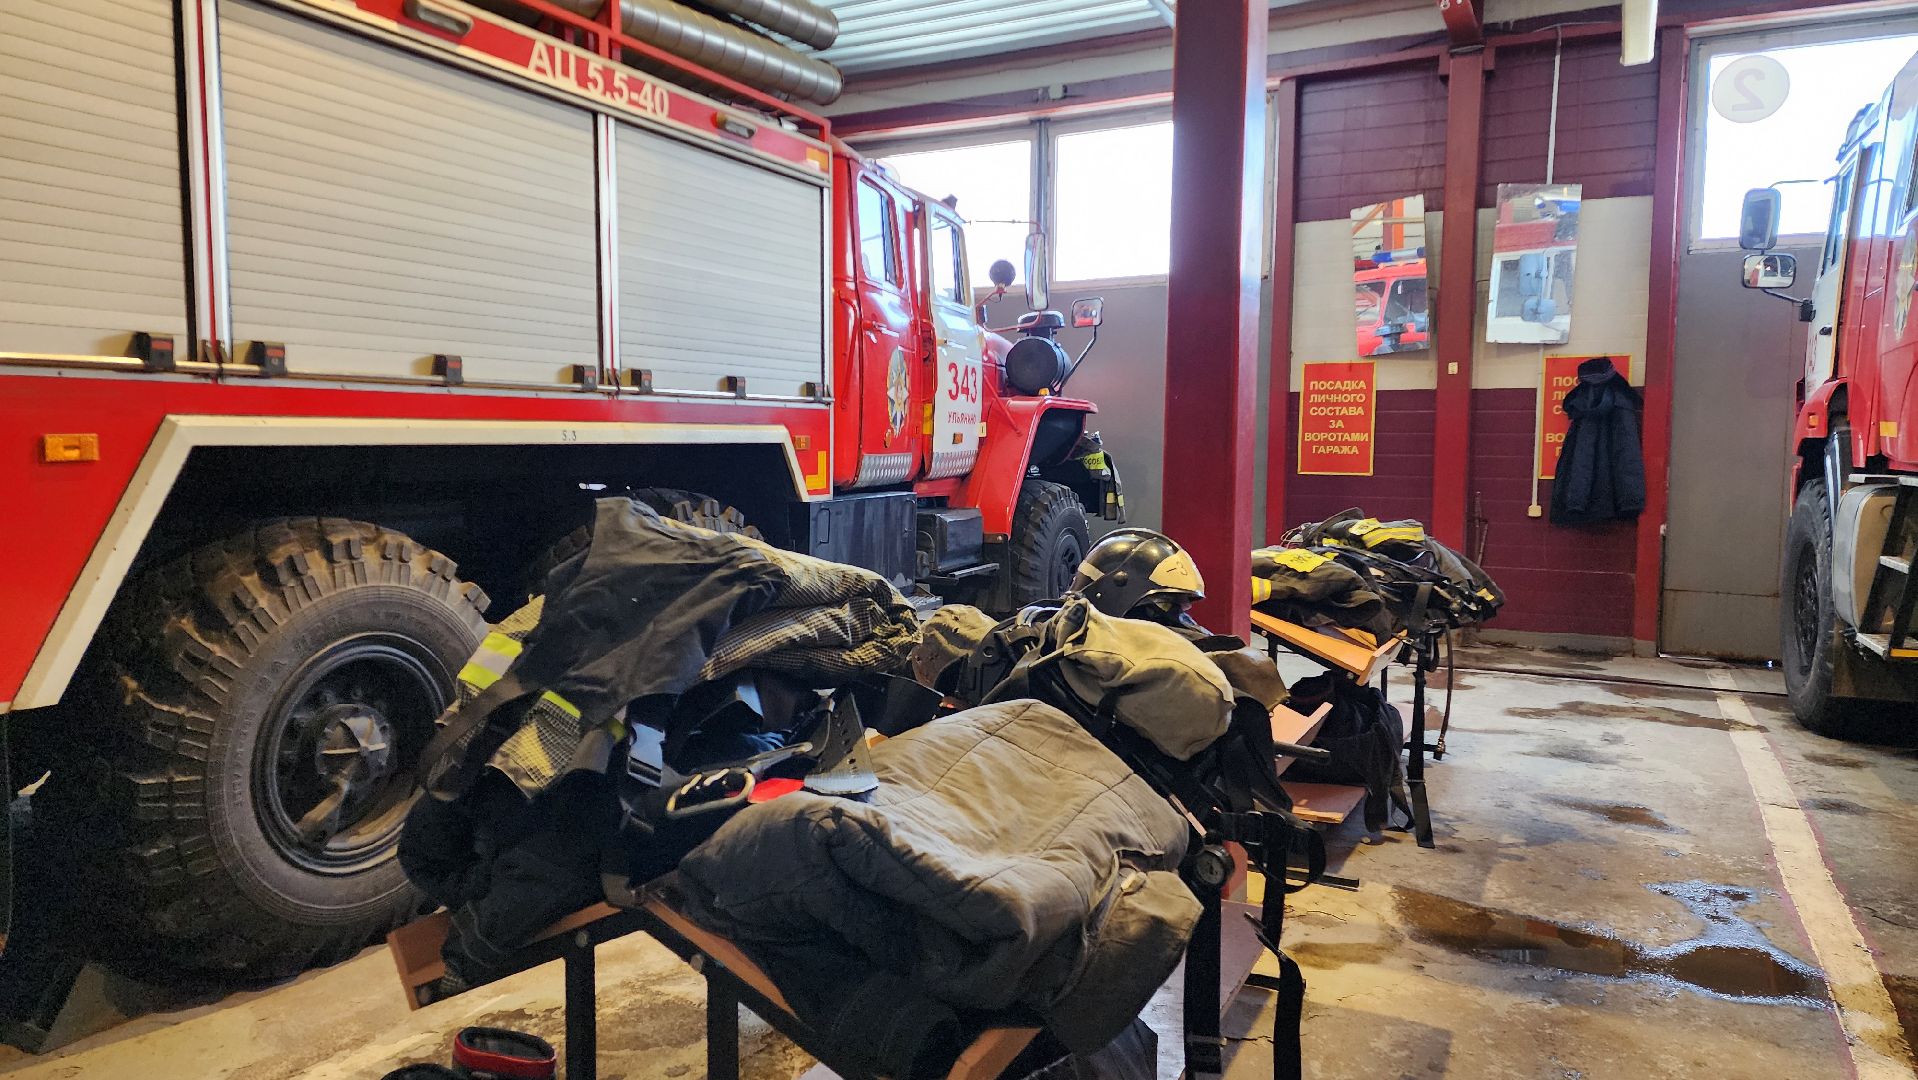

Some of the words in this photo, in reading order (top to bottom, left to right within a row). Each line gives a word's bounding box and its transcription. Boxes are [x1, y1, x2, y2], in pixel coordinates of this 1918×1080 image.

[948, 362, 978, 404] 343
[1310, 380, 1366, 391] ПОСАДКА
[1309, 393, 1366, 403] ЛИЧНОГО
[1309, 406, 1365, 416] СОСТАВА
[1329, 419, 1345, 429] ЗА
[1304, 432, 1369, 442] ВОРОТАМИ
[1312, 445, 1360, 455] ГАРАЖА
